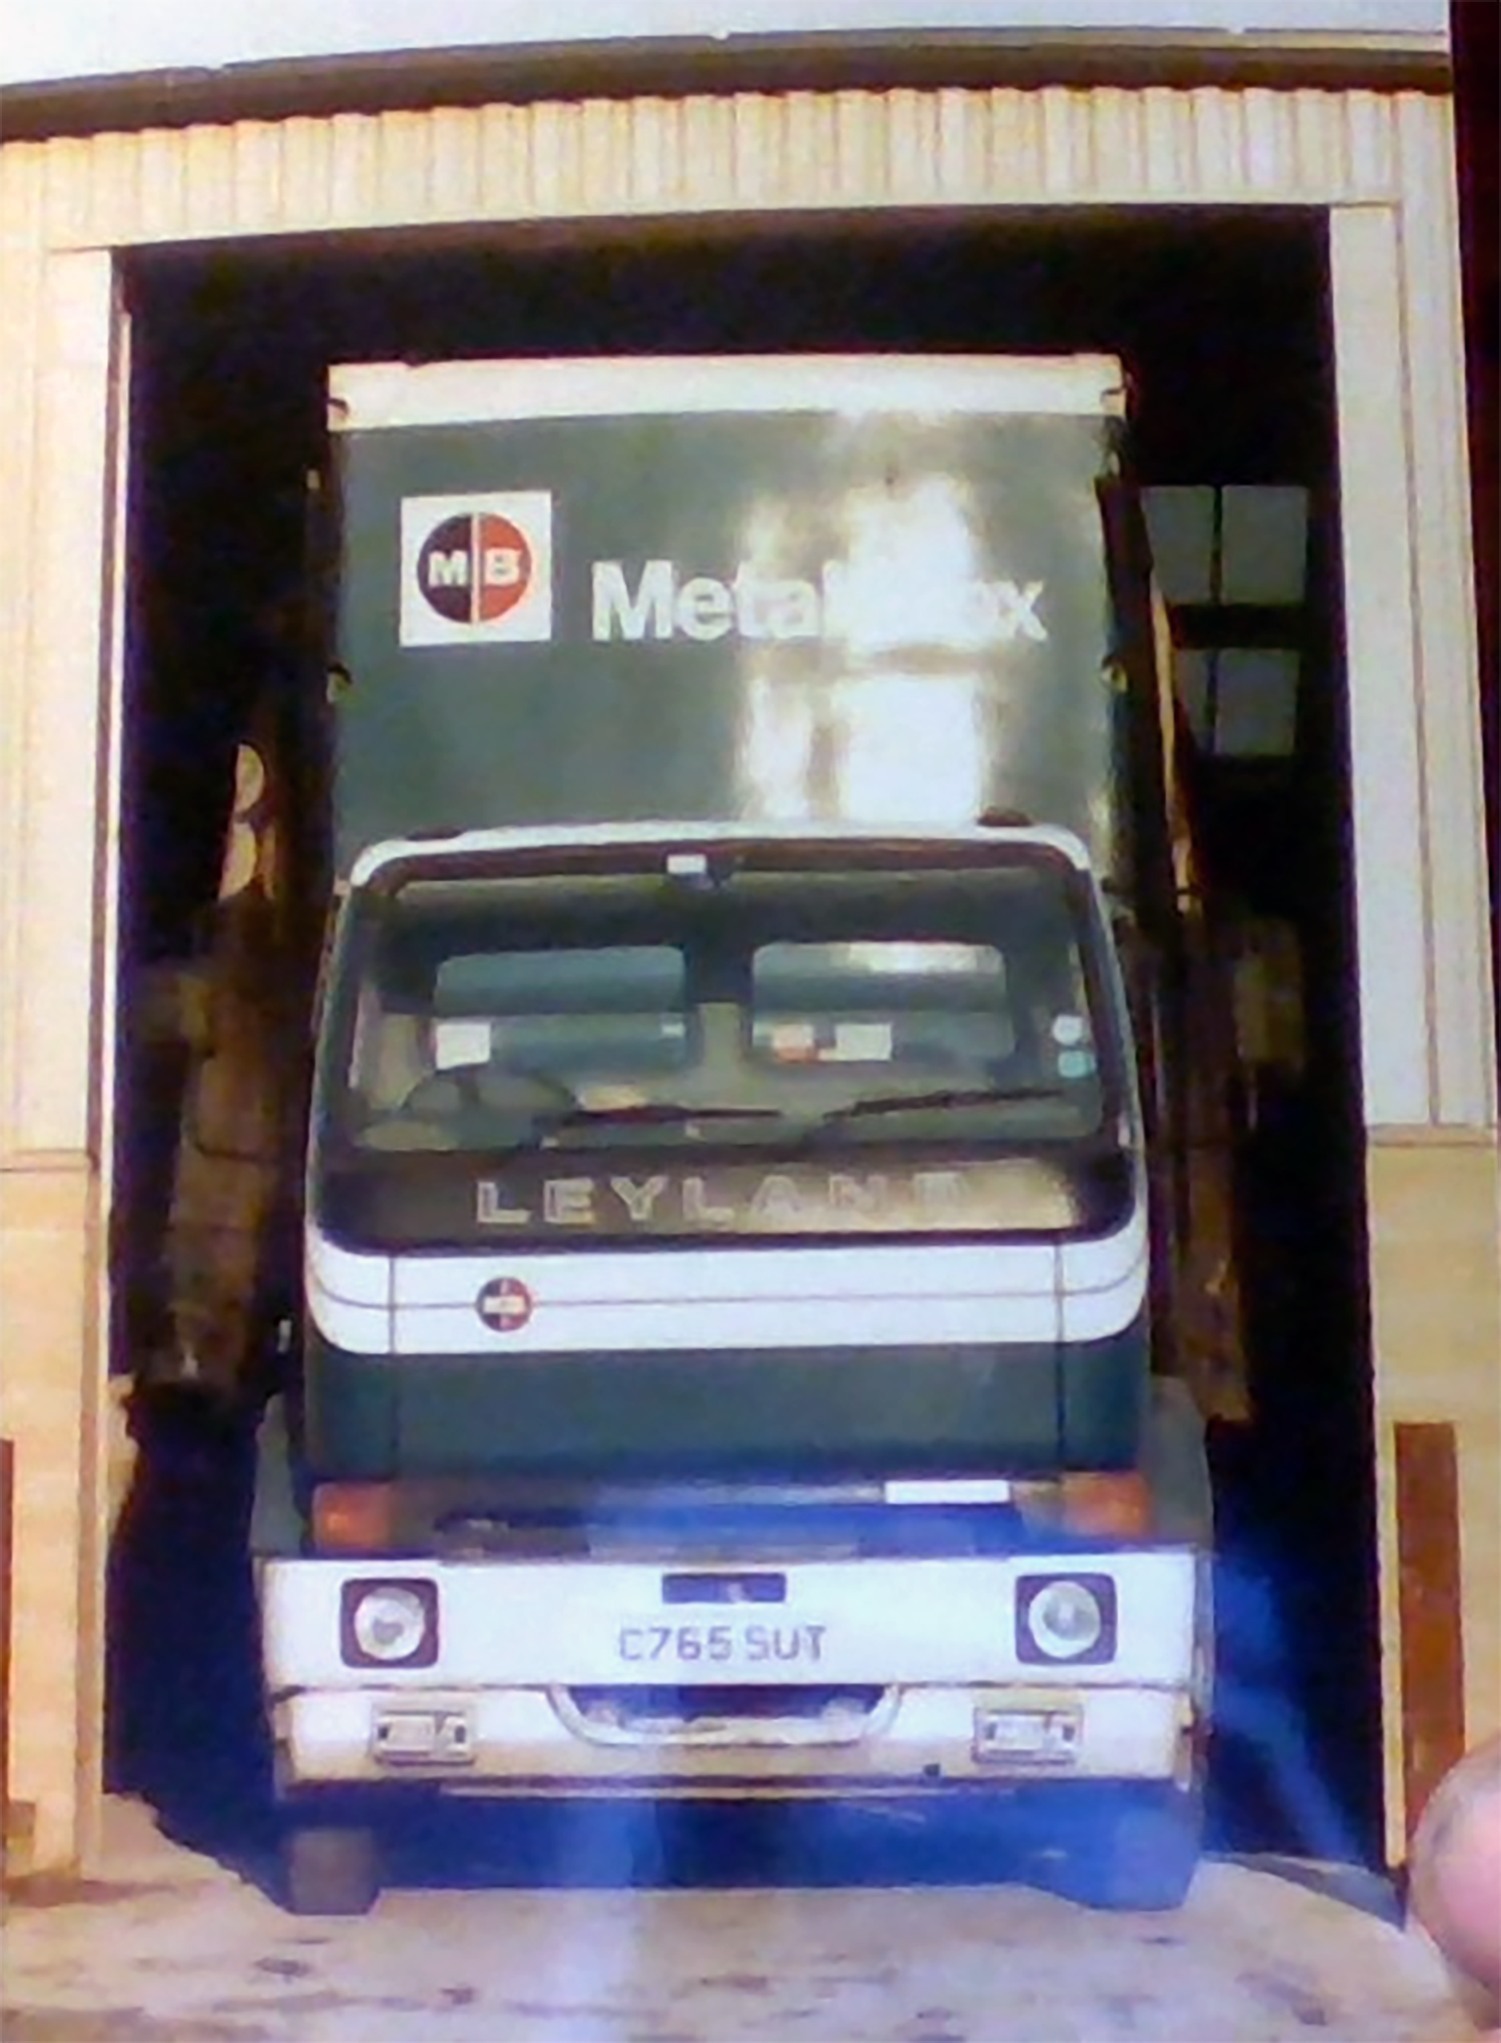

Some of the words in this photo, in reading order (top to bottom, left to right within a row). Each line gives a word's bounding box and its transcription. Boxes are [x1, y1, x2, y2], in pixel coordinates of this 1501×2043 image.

[591, 559, 846, 642] Metal
[619, 1626, 732, 1661] C765
[745, 1624, 827, 1662] SUT
